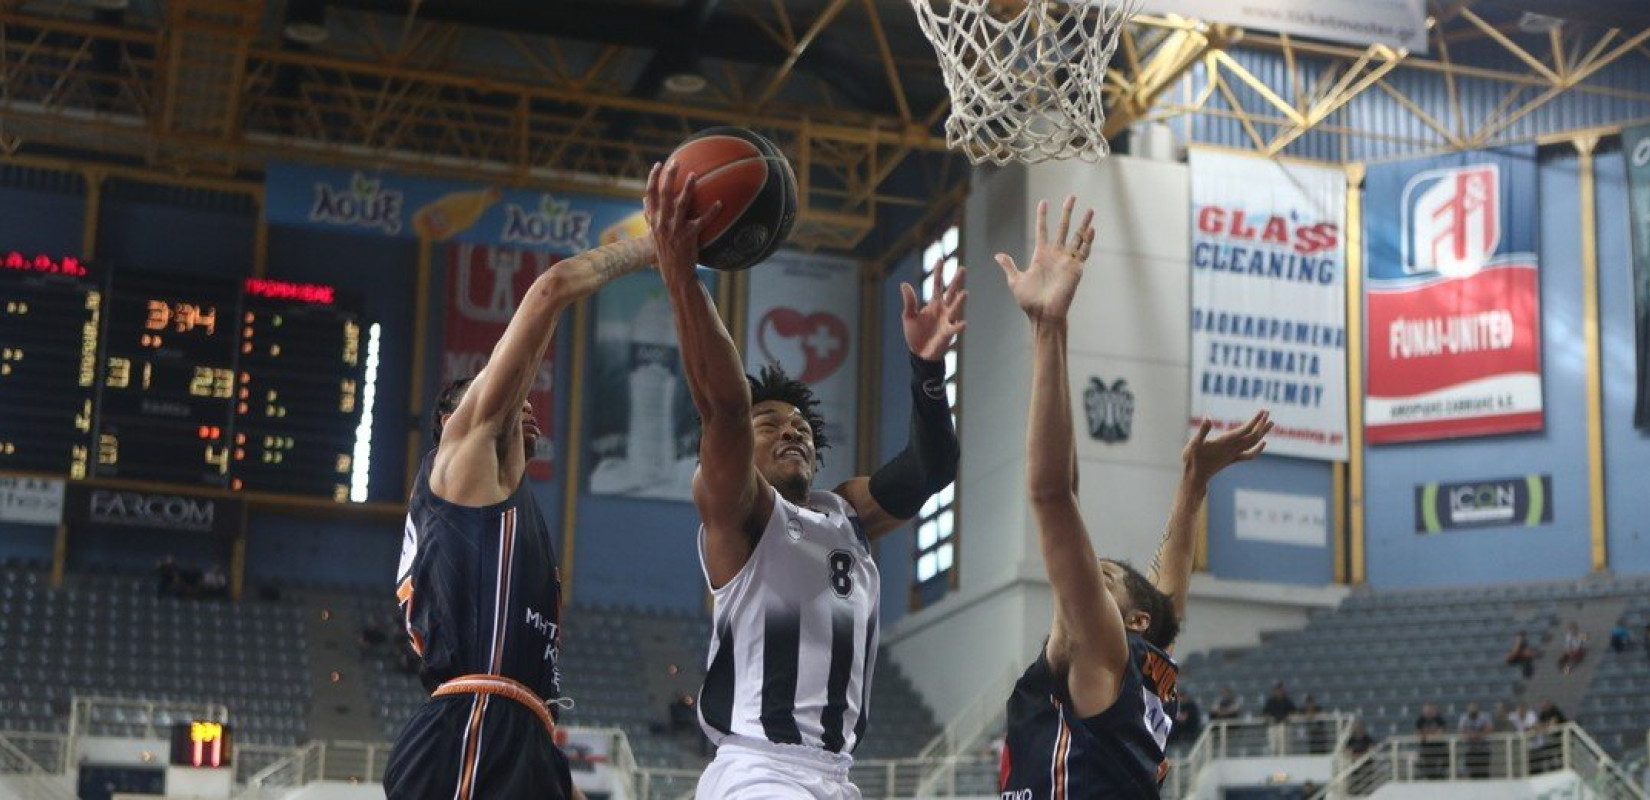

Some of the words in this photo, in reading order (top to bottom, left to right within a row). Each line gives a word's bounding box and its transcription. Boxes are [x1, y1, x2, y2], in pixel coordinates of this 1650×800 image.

[1198, 206, 1338, 254] GLASS
[1194, 242, 1335, 285] CLEANING
[1389, 308, 1514, 360] FUNAI-UNITED
[91, 492, 214, 525] FARCOM
[1450, 482, 1514, 512] ICON
[827, 549, 855, 598] 8
